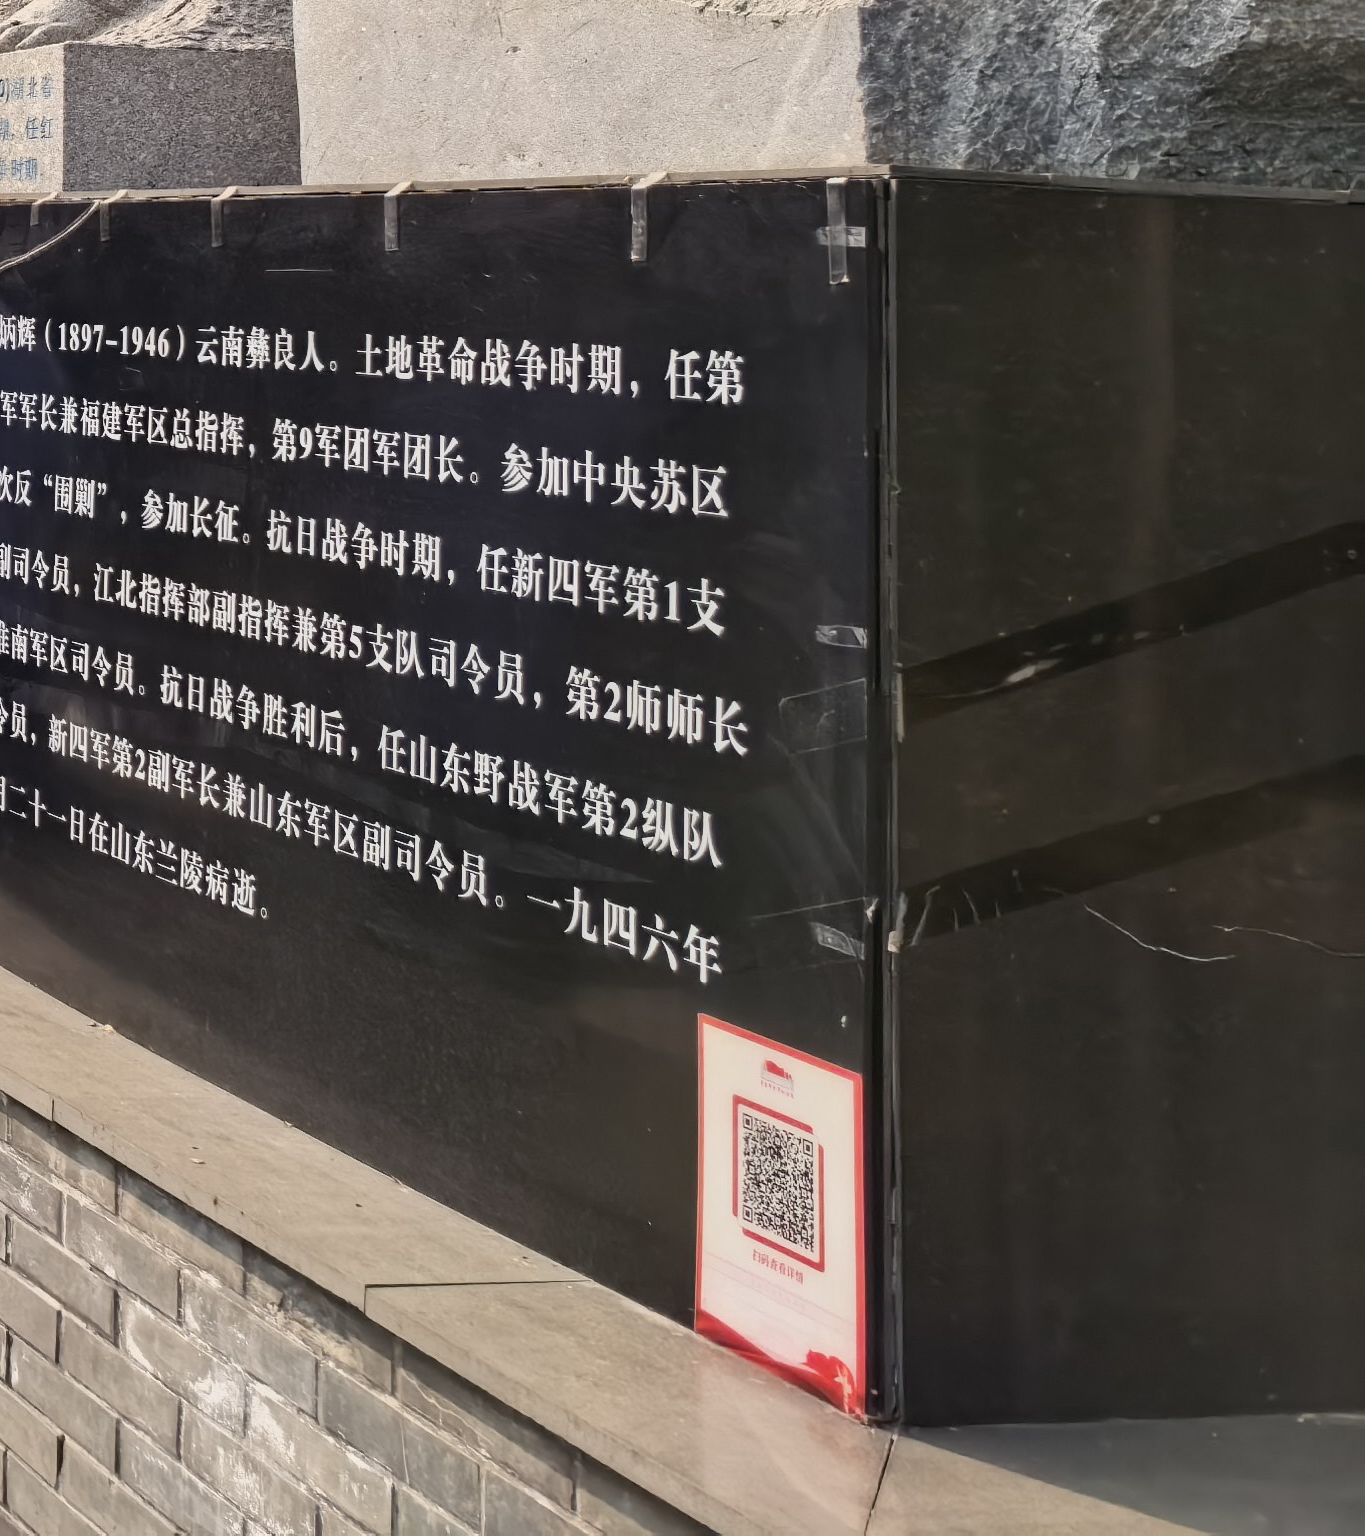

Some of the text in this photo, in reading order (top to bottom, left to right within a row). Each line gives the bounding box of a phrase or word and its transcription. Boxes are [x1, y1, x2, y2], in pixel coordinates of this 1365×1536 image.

[752, 1248, 804, 1285] 扫码查看详情
